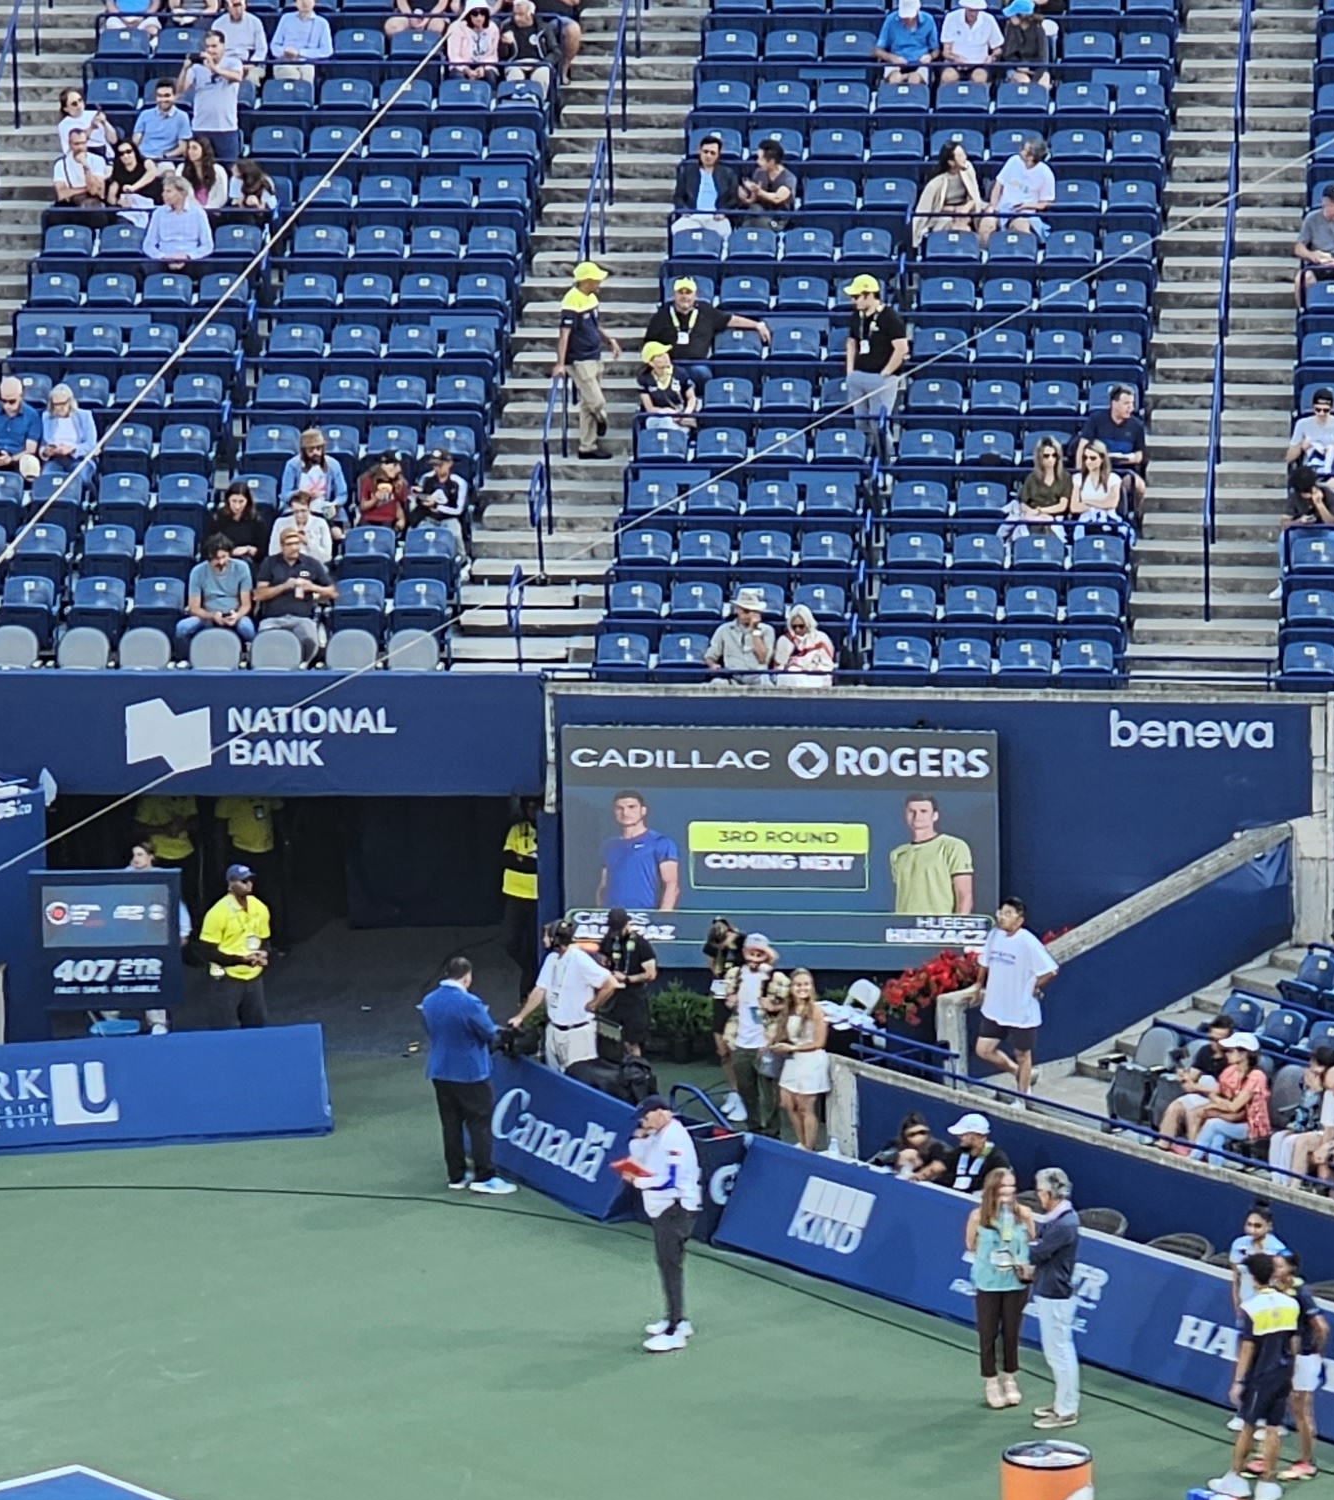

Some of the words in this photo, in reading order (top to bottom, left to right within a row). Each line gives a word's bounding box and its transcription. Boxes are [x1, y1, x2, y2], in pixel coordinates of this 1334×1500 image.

[228, 707, 398, 734] NATIONAL
[1110, 709, 1273, 749] beneva
[228, 739, 325, 766] BANK
[569, 748, 772, 771] CADILLAC
[835, 745, 991, 779] ROGERS
[718, 830, 759, 843] 3RD
[765, 831, 839, 844] ROUND
[704, 853, 798, 870] COMING
[799, 855, 855, 871] NEXT
[53, 959, 117, 982] 407
[491, 1088, 606, 1183] Canada
[787, 1208, 863, 1255] KIND
